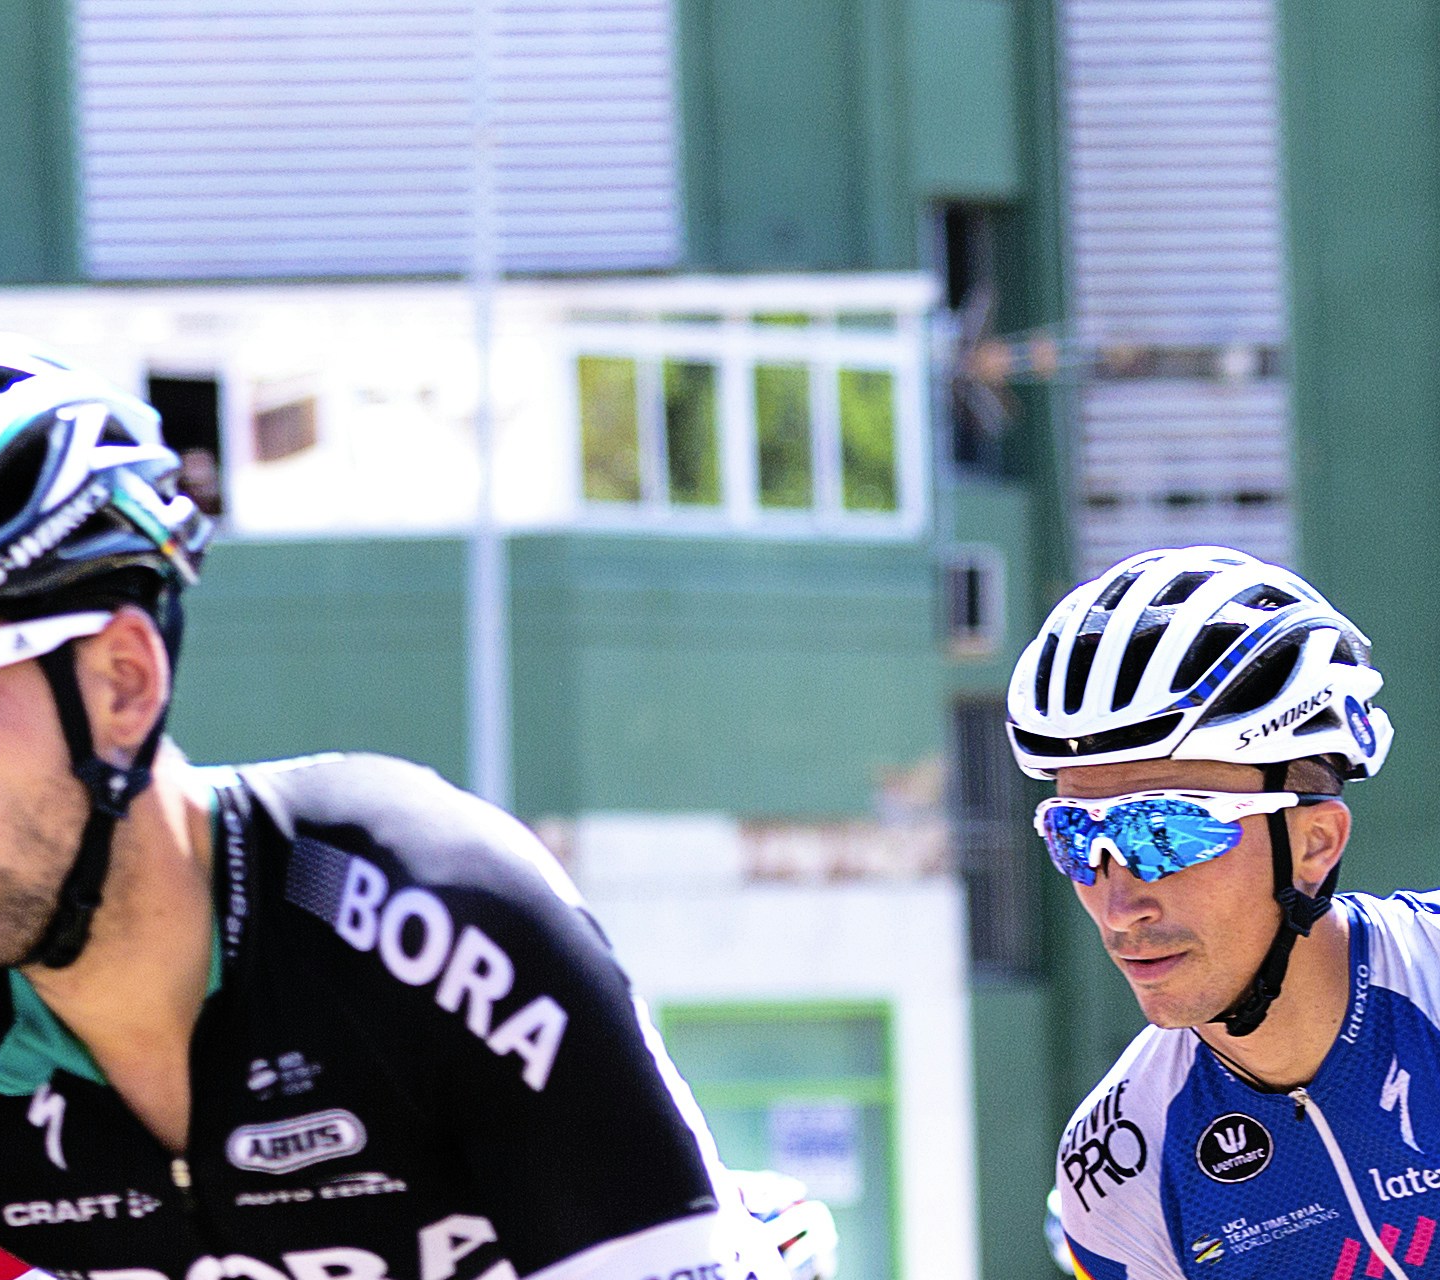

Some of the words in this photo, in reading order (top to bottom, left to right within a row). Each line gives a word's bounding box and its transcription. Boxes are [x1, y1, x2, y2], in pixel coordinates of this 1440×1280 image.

[1235, 685, 1334, 750] S-WORKS
[337, 857, 567, 1091] BORA
[248, 1124, 343, 1160] ABUS
[1212, 1147, 1265, 1174] vermarc
[1064, 1119, 1147, 1213] PRO
[2, 1195, 120, 1227] CRAFT
[1221, 1218, 1247, 1234] UCI
[1226, 1225, 1261, 1244] TEAM
[1262, 1216, 1288, 1231] TIME
[1289, 1203, 1325, 1221] TRIAL
[1230, 1232, 1272, 1254] WORLD
[1272, 1208, 1340, 1240] CHAMPIONS
